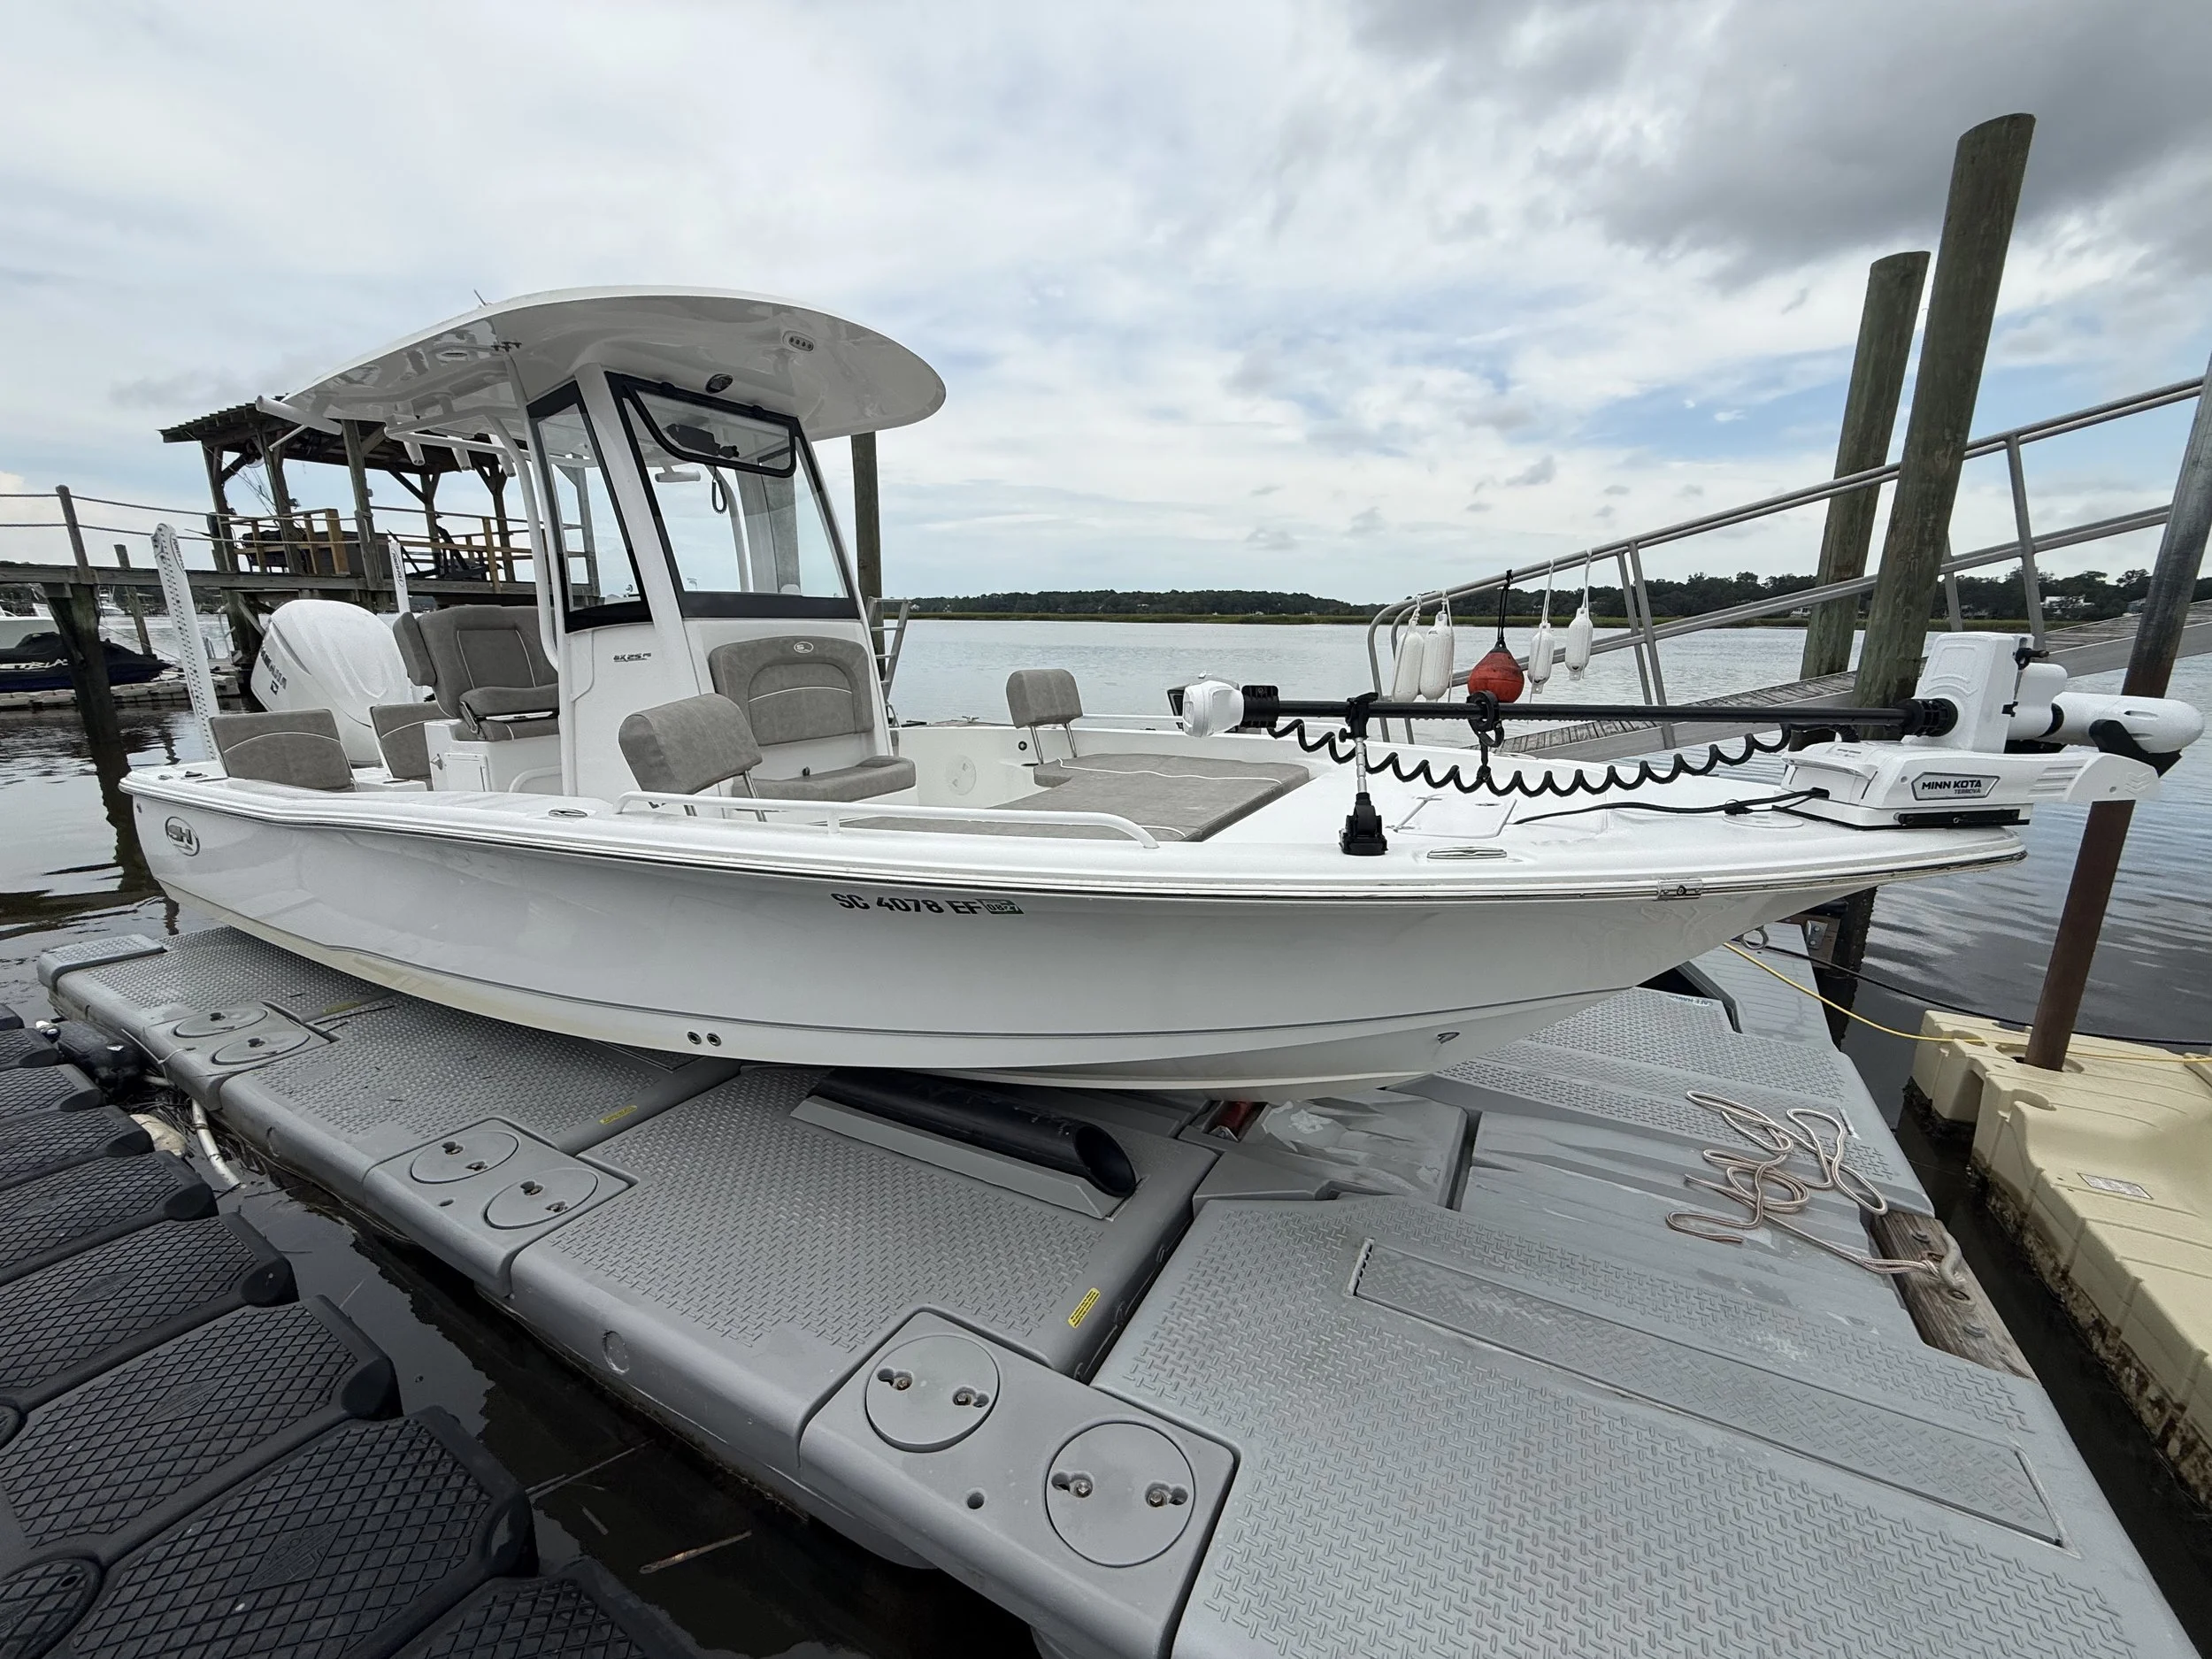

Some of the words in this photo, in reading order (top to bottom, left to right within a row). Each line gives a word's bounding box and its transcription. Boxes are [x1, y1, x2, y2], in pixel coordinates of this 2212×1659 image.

[1921, 780, 1952, 790] MINN
[1953, 780, 1982, 789] KOTA
[830, 893, 871, 910] SC
[876, 896, 944, 914] 4078
[945, 900, 982, 915] EF
